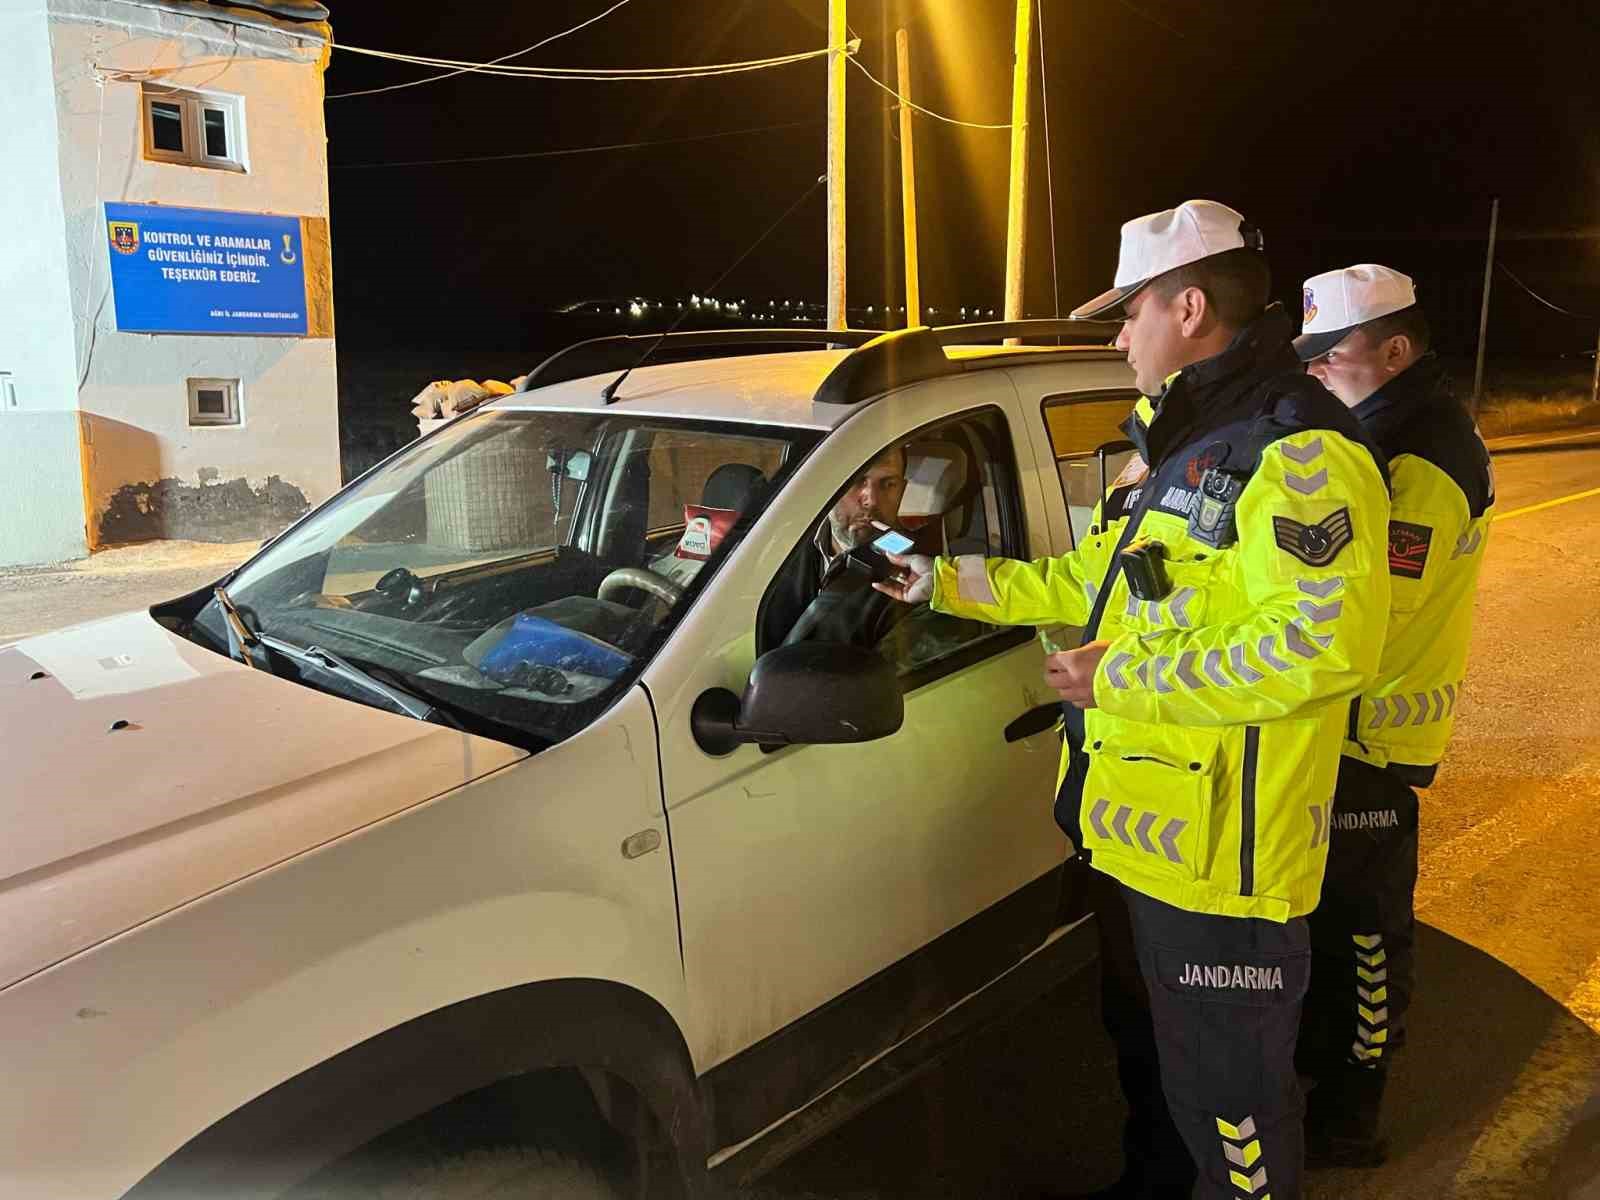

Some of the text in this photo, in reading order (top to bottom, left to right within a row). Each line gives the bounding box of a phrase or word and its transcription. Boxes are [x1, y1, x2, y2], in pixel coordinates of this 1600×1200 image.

[143, 231, 271, 251] KONTROL VE ARAMALAR
[148, 247, 270, 268] GÜVENLİĞİNİZ İÇİNDİR.
[161, 265, 260, 283] TEŞEKKÜR EDERİZ.
[1329, 809, 1399, 830] ANDARMA
[1179, 963, 1283, 990] JANDARMA
